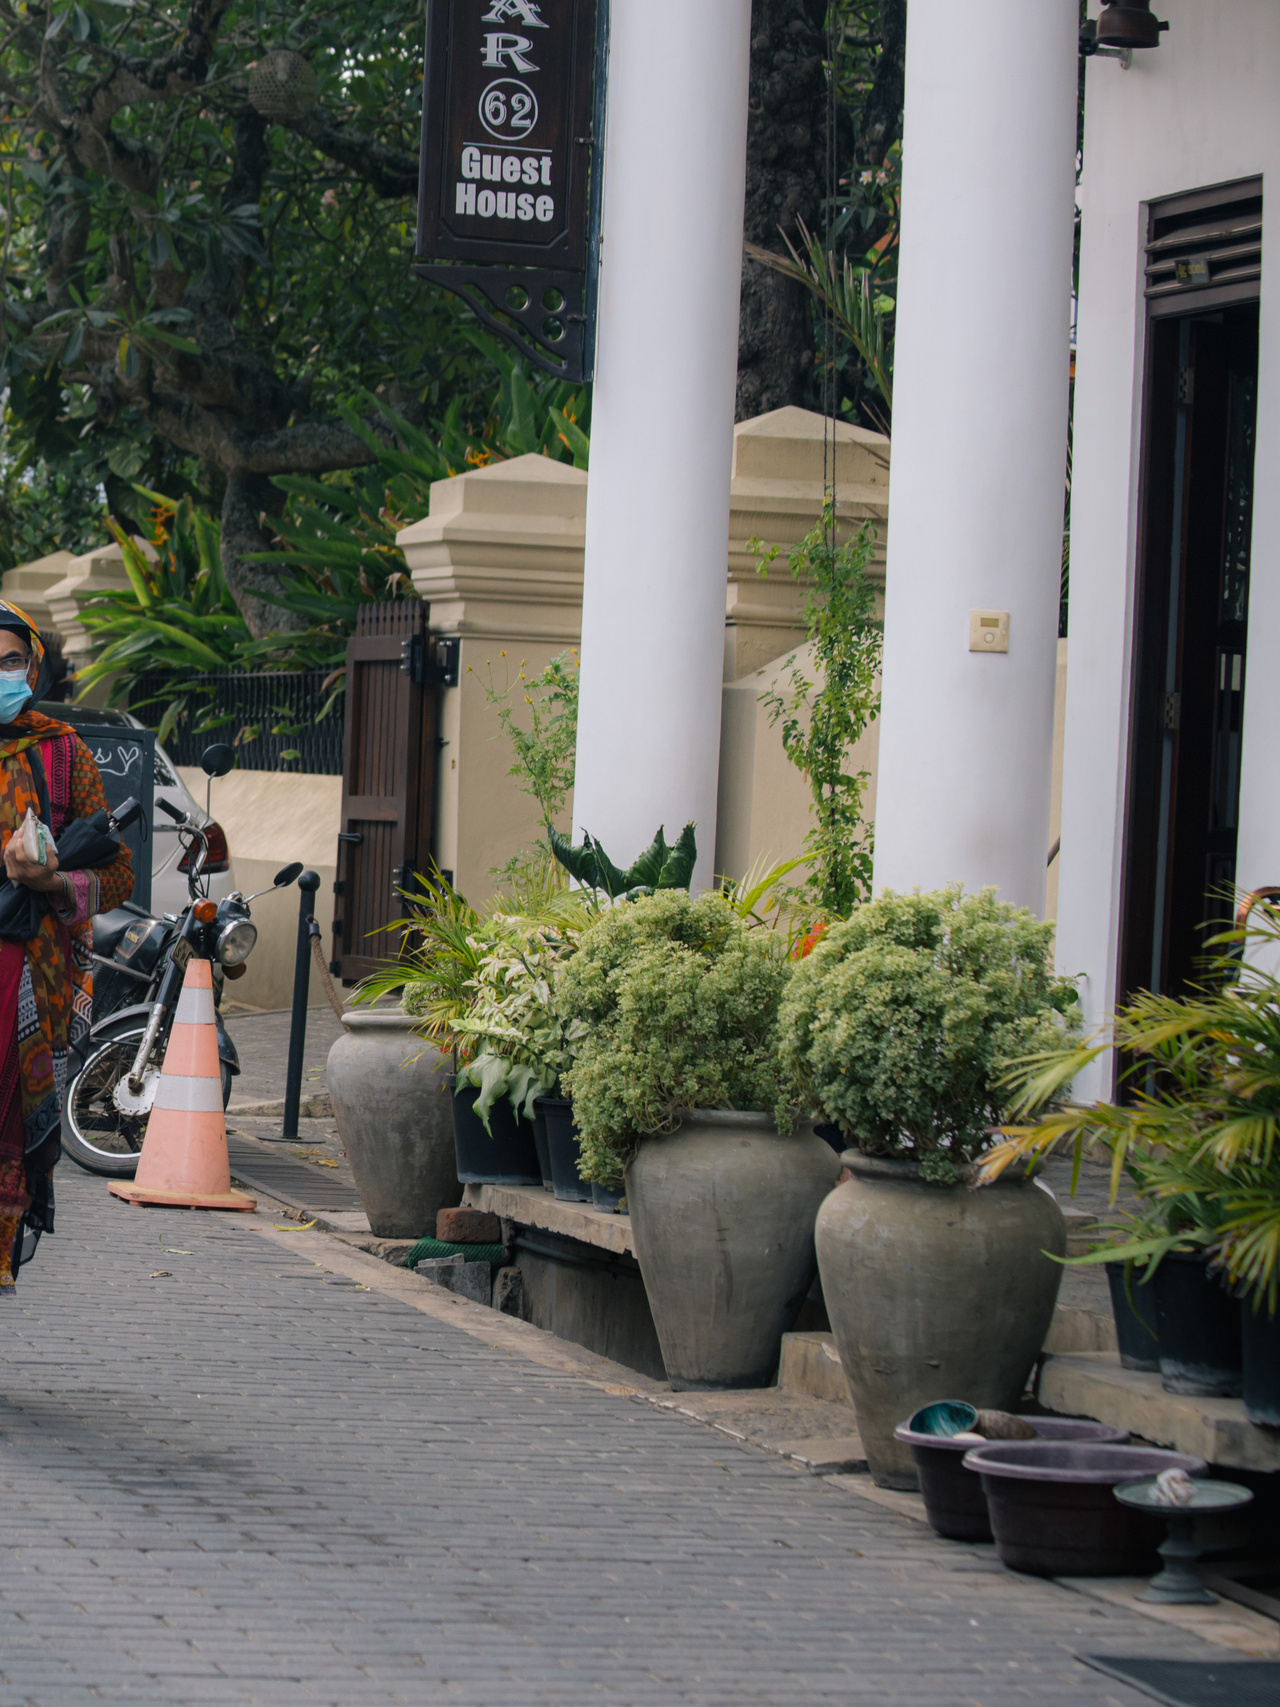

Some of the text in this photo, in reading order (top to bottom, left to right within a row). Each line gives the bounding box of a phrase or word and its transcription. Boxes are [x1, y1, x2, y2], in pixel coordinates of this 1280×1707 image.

[484, 90, 532, 128] 62
[461, 146, 552, 186] Guest
[455, 182, 554, 222] House
